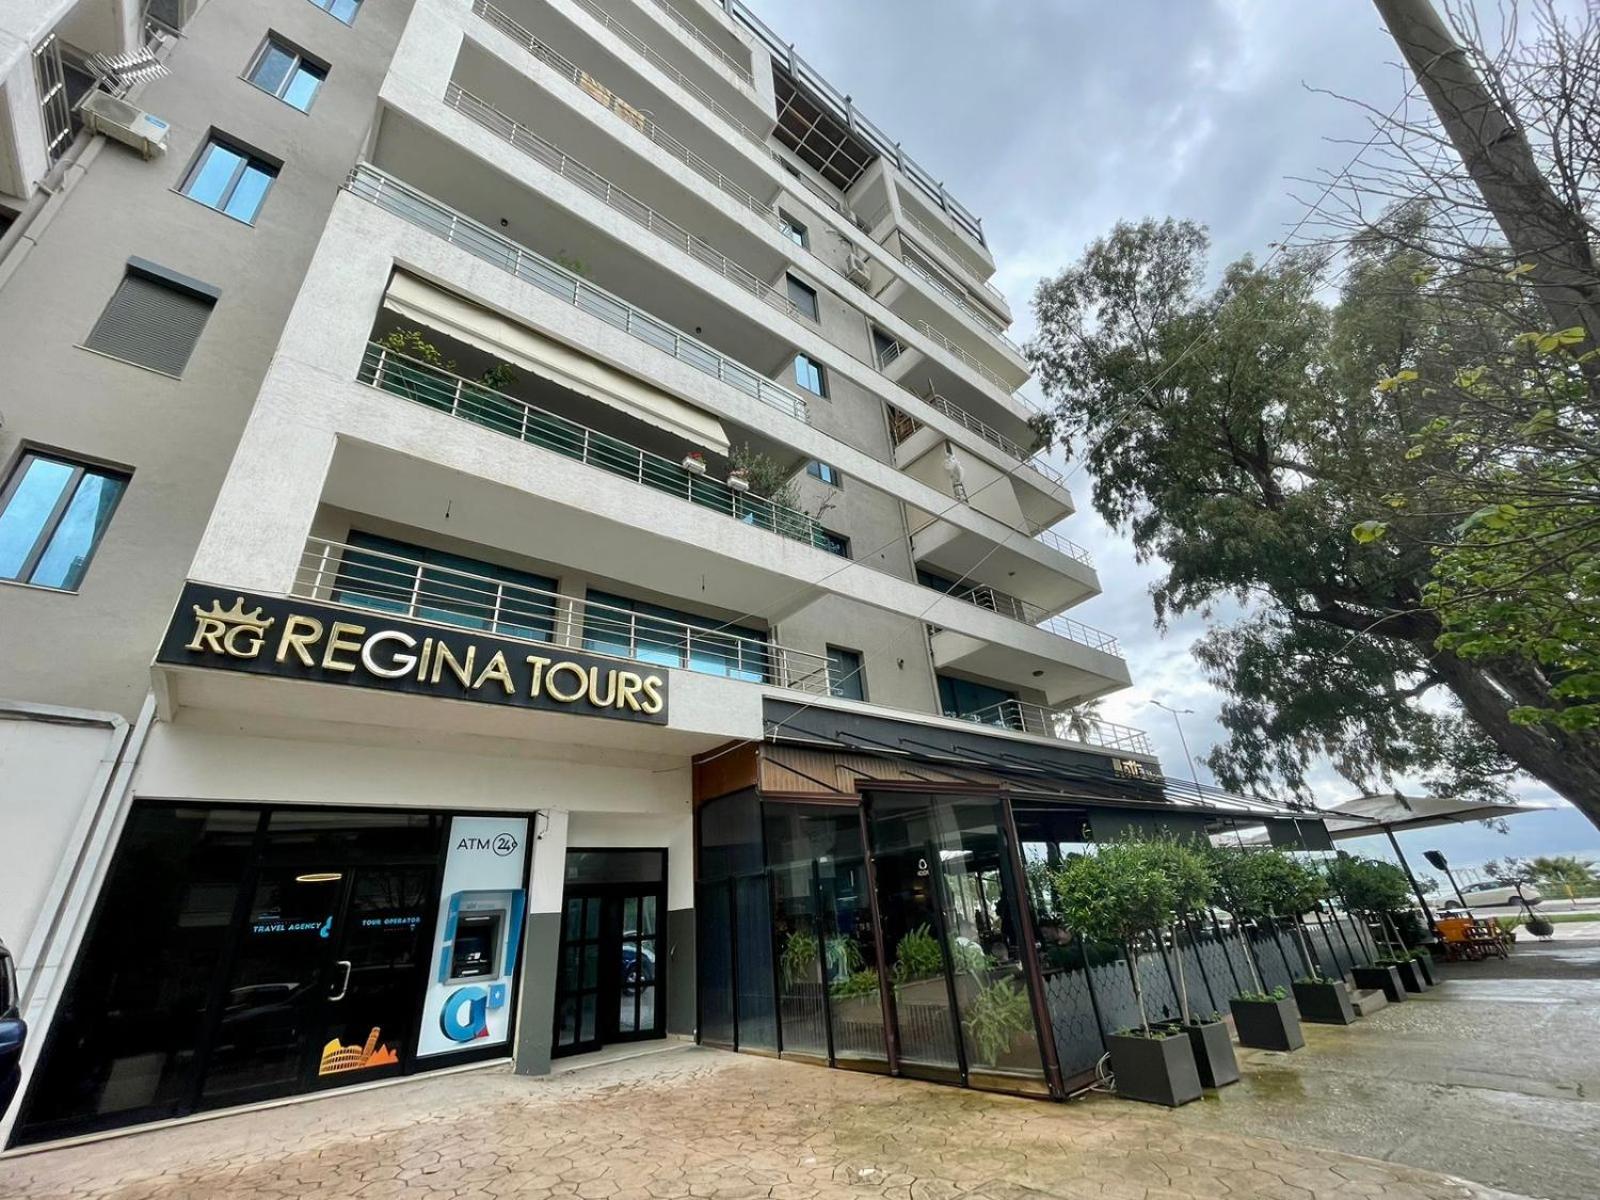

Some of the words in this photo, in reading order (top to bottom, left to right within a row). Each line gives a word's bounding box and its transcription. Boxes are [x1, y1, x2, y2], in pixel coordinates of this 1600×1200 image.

[185, 616, 265, 659] RG
[276, 614, 515, 695] REGINA
[526, 655, 664, 715] TOURS
[456, 838, 490, 850] ATM
[384, 916, 420, 925] OPERATOR
[253, 924, 286, 933] TRAVEL
[287, 922, 322, 931] AGENCY
